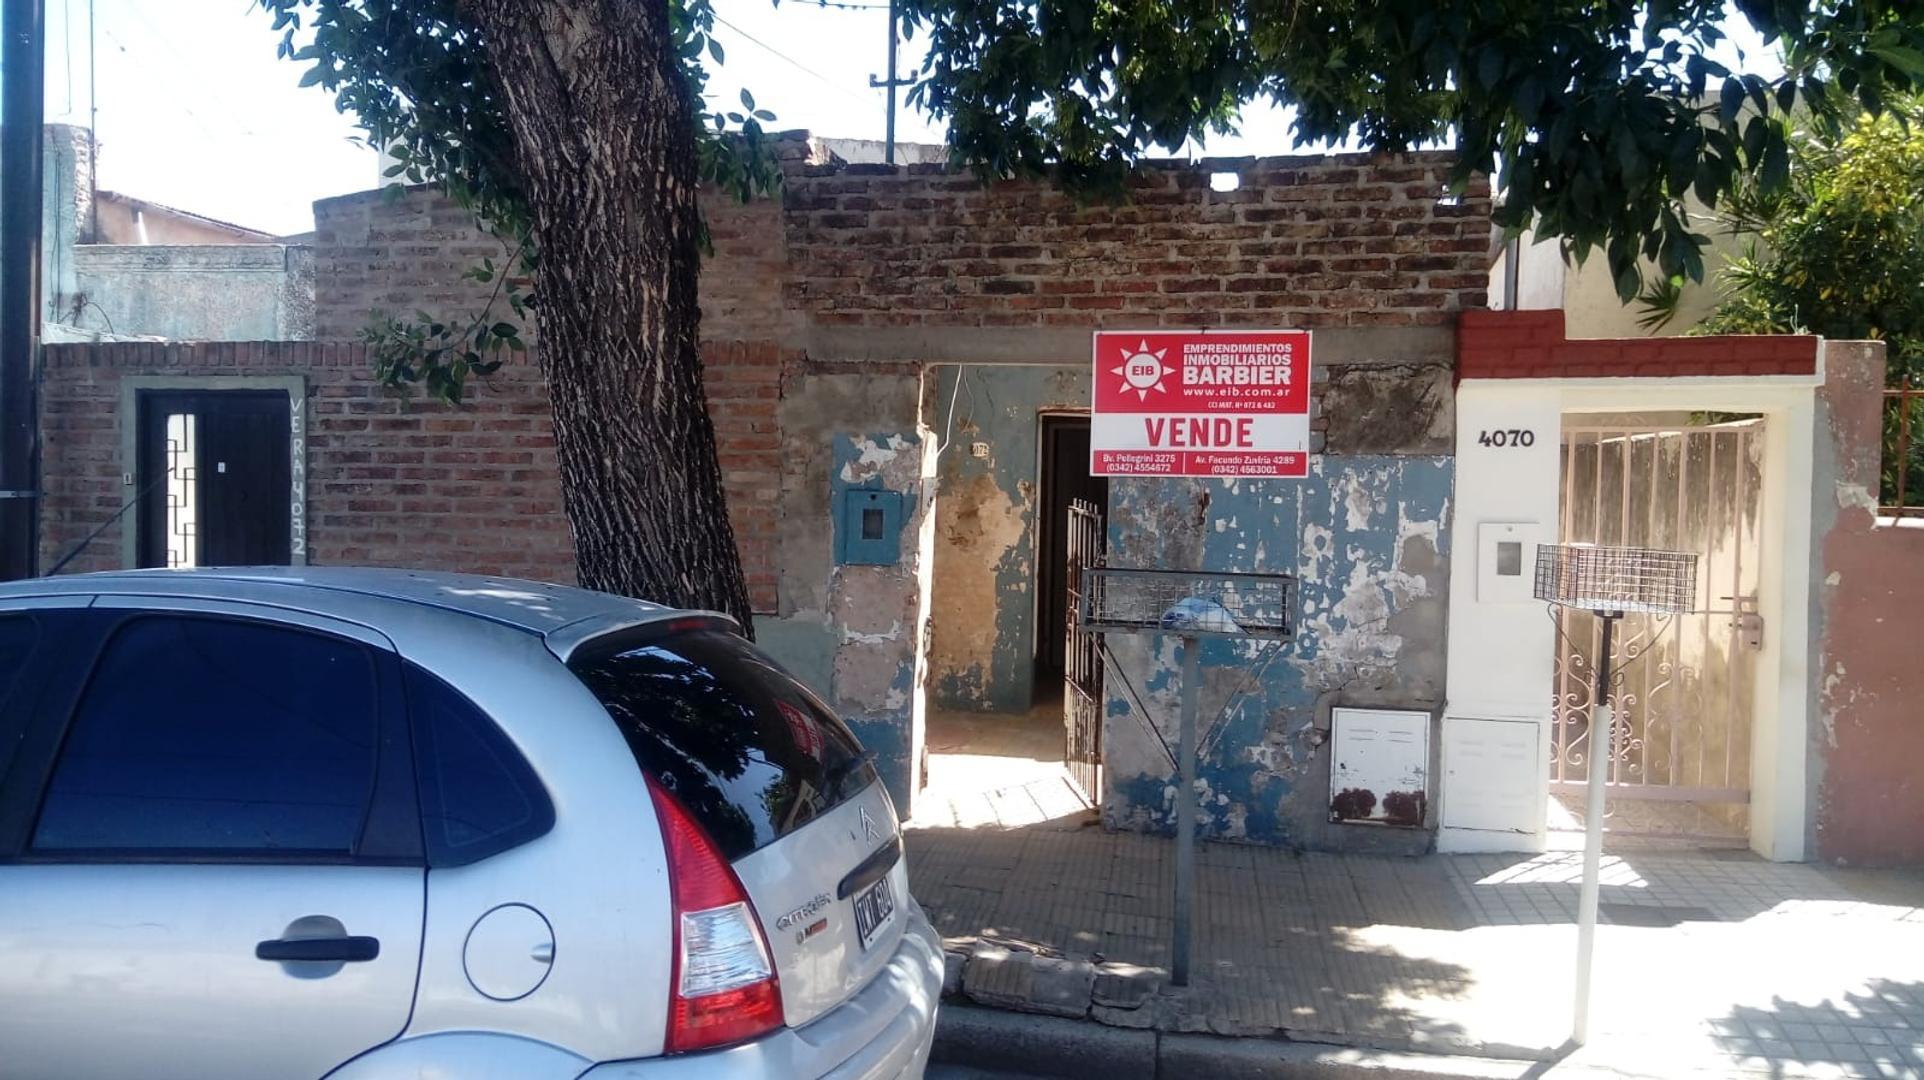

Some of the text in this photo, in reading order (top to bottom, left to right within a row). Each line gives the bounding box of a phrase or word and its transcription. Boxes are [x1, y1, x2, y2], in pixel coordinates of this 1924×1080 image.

[1183, 343, 1293, 354] EMPRENDIMIENTOS
[1183, 353, 1292, 366] INMOBILIARIOS
[1131, 365, 1155, 376] EIB
[1182, 366, 1291, 385] BARBIER
[1183, 387, 1290, 397] www.eib.com.ar
[1145, 417, 1254, 447] VENDE
[1478, 429, 1535, 447] 4070
[1116, 453, 1154, 465] Pellegrini
[1155, 454, 1176, 463] 3275
[1195, 455, 1207, 464] Av.
[1208, 455, 1243, 464] Facundo
[1272, 456, 1296, 465] 4289
[1107, 463, 1133, 472] (0342)
[1211, 465, 1238, 475] (0342)
[289, 397, 307, 555] VERA 4072
